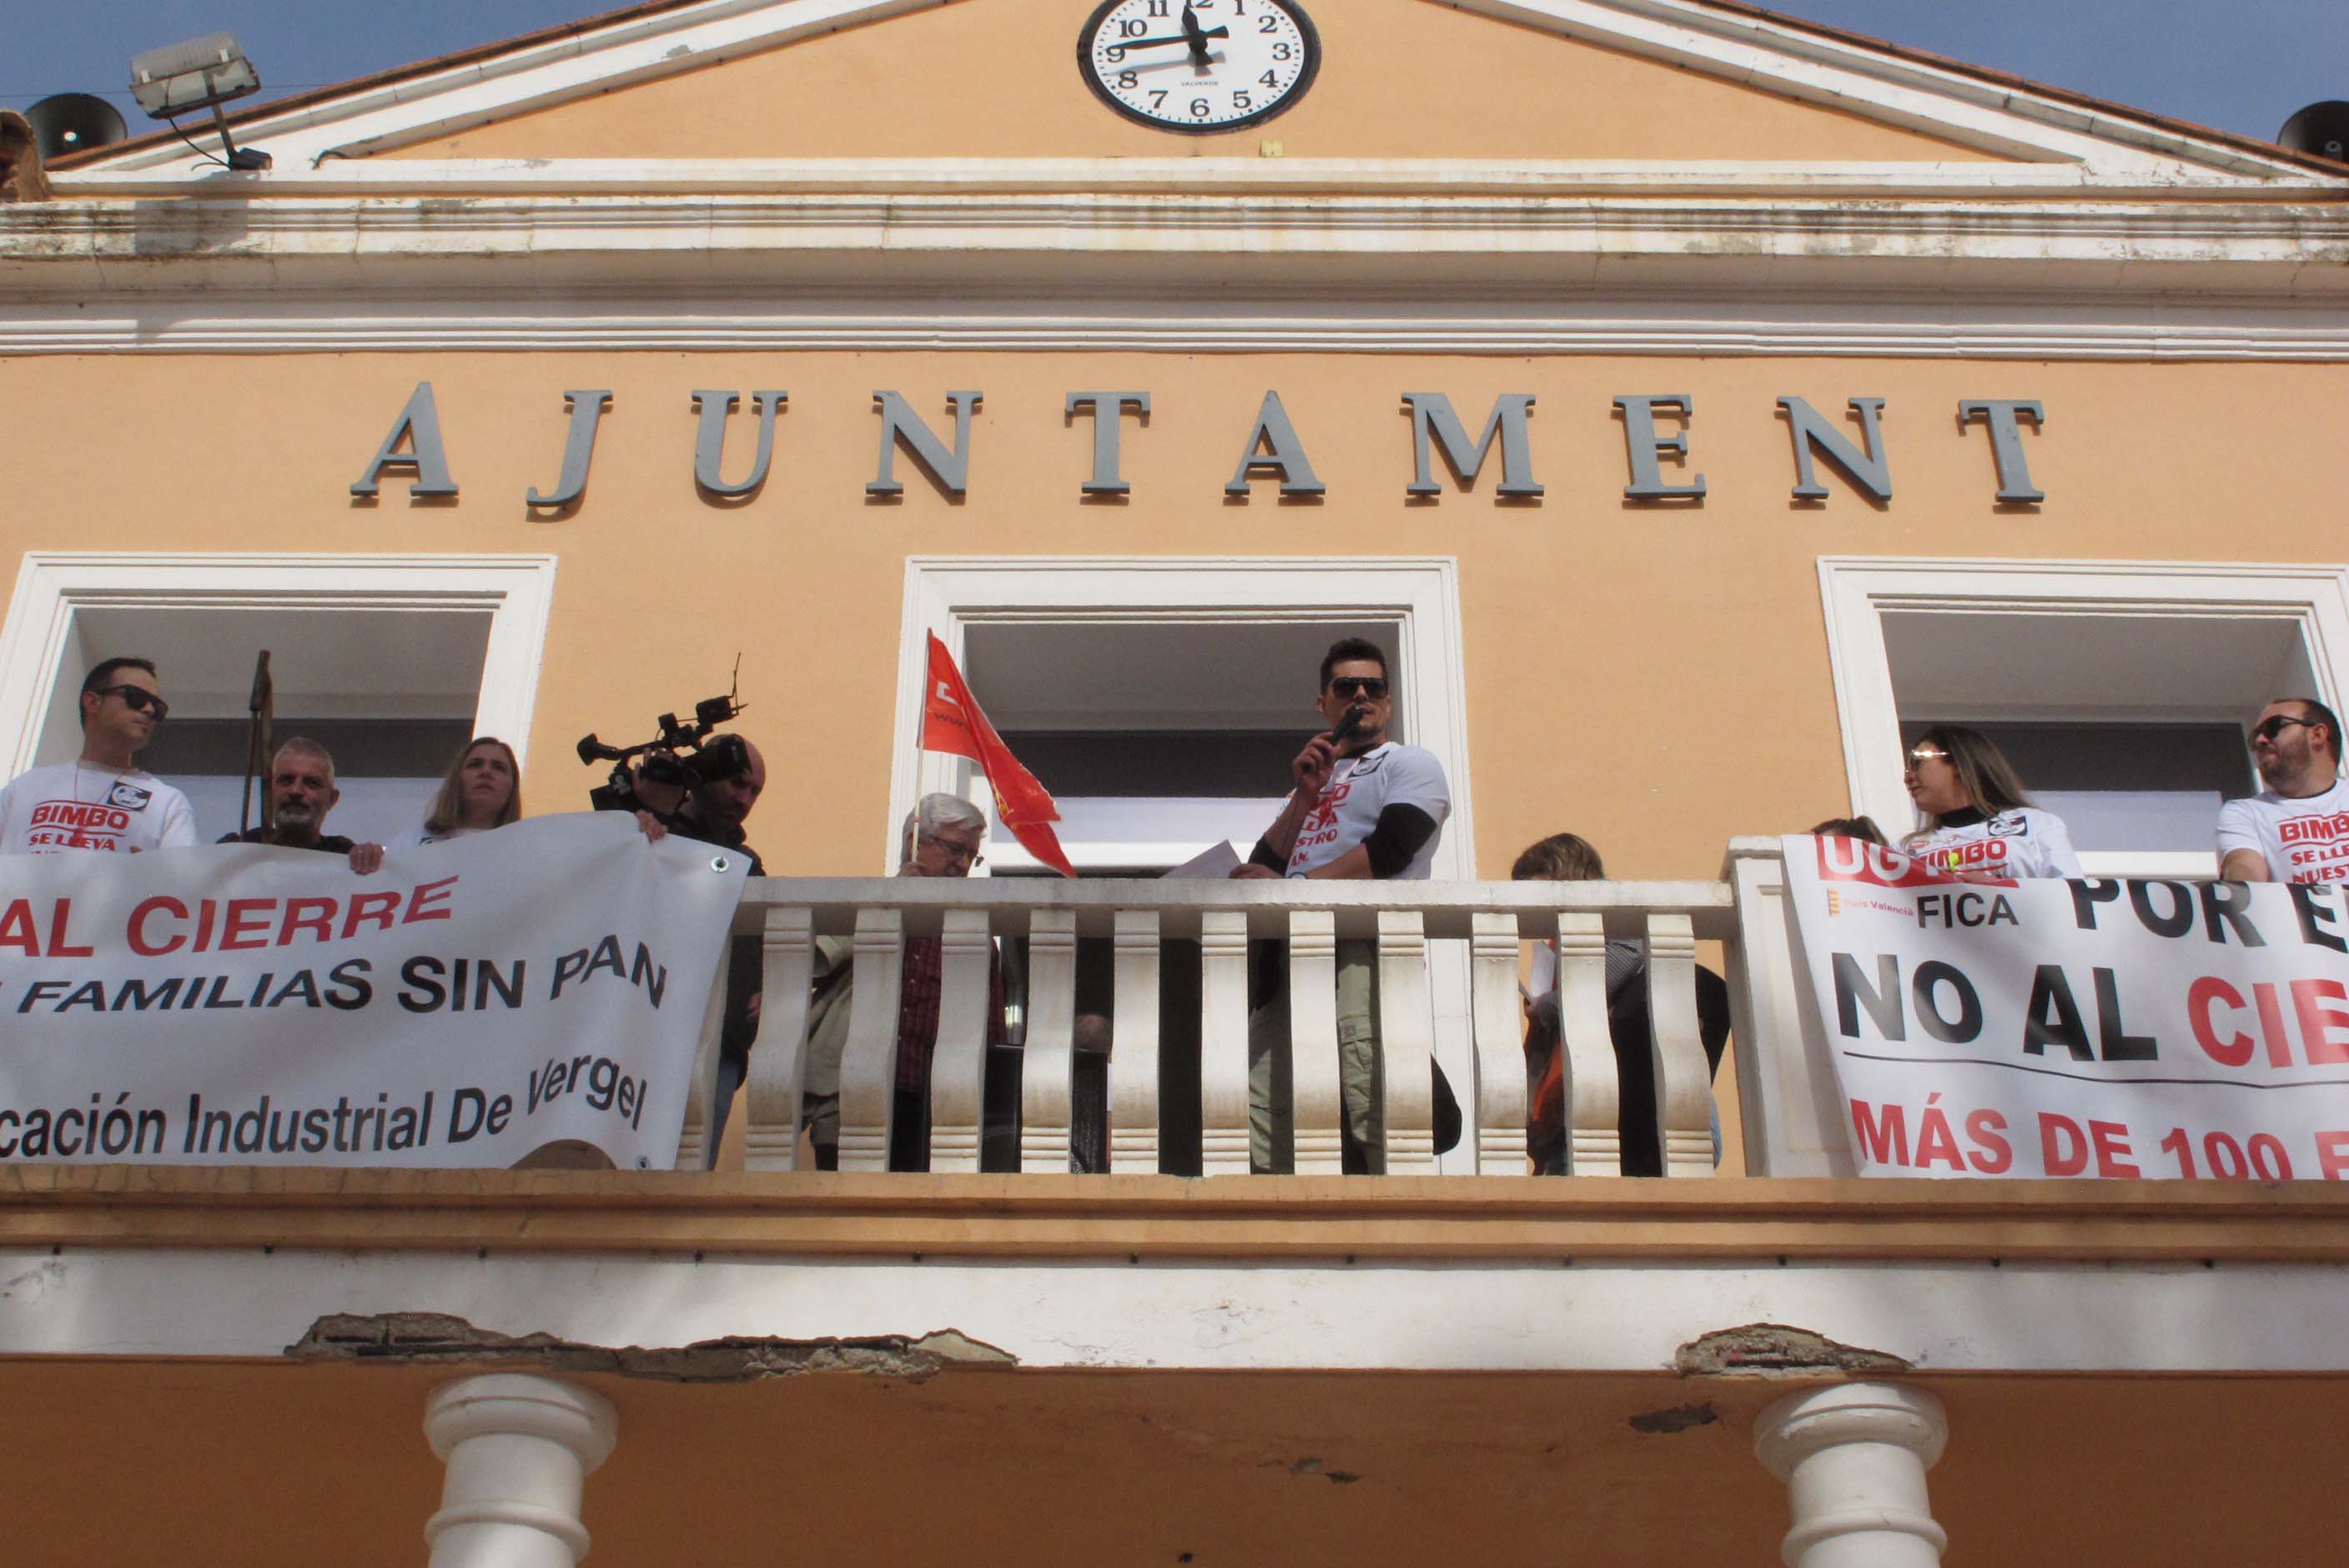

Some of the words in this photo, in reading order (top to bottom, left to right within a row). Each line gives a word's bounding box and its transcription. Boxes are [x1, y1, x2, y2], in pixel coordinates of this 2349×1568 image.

[1119, 19, 1148, 38] 10
[1259, 16, 1278, 33] 2
[1106, 46, 1125, 63] 9
[1272, 43, 1290, 61] 3
[1118, 71, 1139, 88] 8
[1259, 69, 1279, 88] 4
[1149, 90, 1168, 109] 7
[1190, 98, 1210, 117] 6
[1233, 90, 1251, 108] 5
[350, 381, 2045, 506] AJUNTAMENT
[31, 806, 129, 830] BIMBO
[29, 833, 52, 846] SE
[2291, 851, 2316, 866] SE
[0, 898, 93, 957] AL
[127, 875, 458, 957] CIERRE
[1918, 892, 2019, 928] FICA
[2065, 879, 2267, 947] POR
[17, 957, 373, 1013] FAMILIAS
[397, 956, 526, 1012] SIN
[550, 934, 666, 1009] PAN
[1832, 952, 1983, 1043] NO
[2024, 964, 2158, 1061] AL
[184, 1091, 434, 1153] Industrial
[447, 1088, 512, 1143] De
[527, 1055, 647, 1129] Vergel
[1850, 1093, 2012, 1175] MÁS
[2038, 1112, 2140, 1179] DE
[2160, 1128, 2293, 1181] 100
